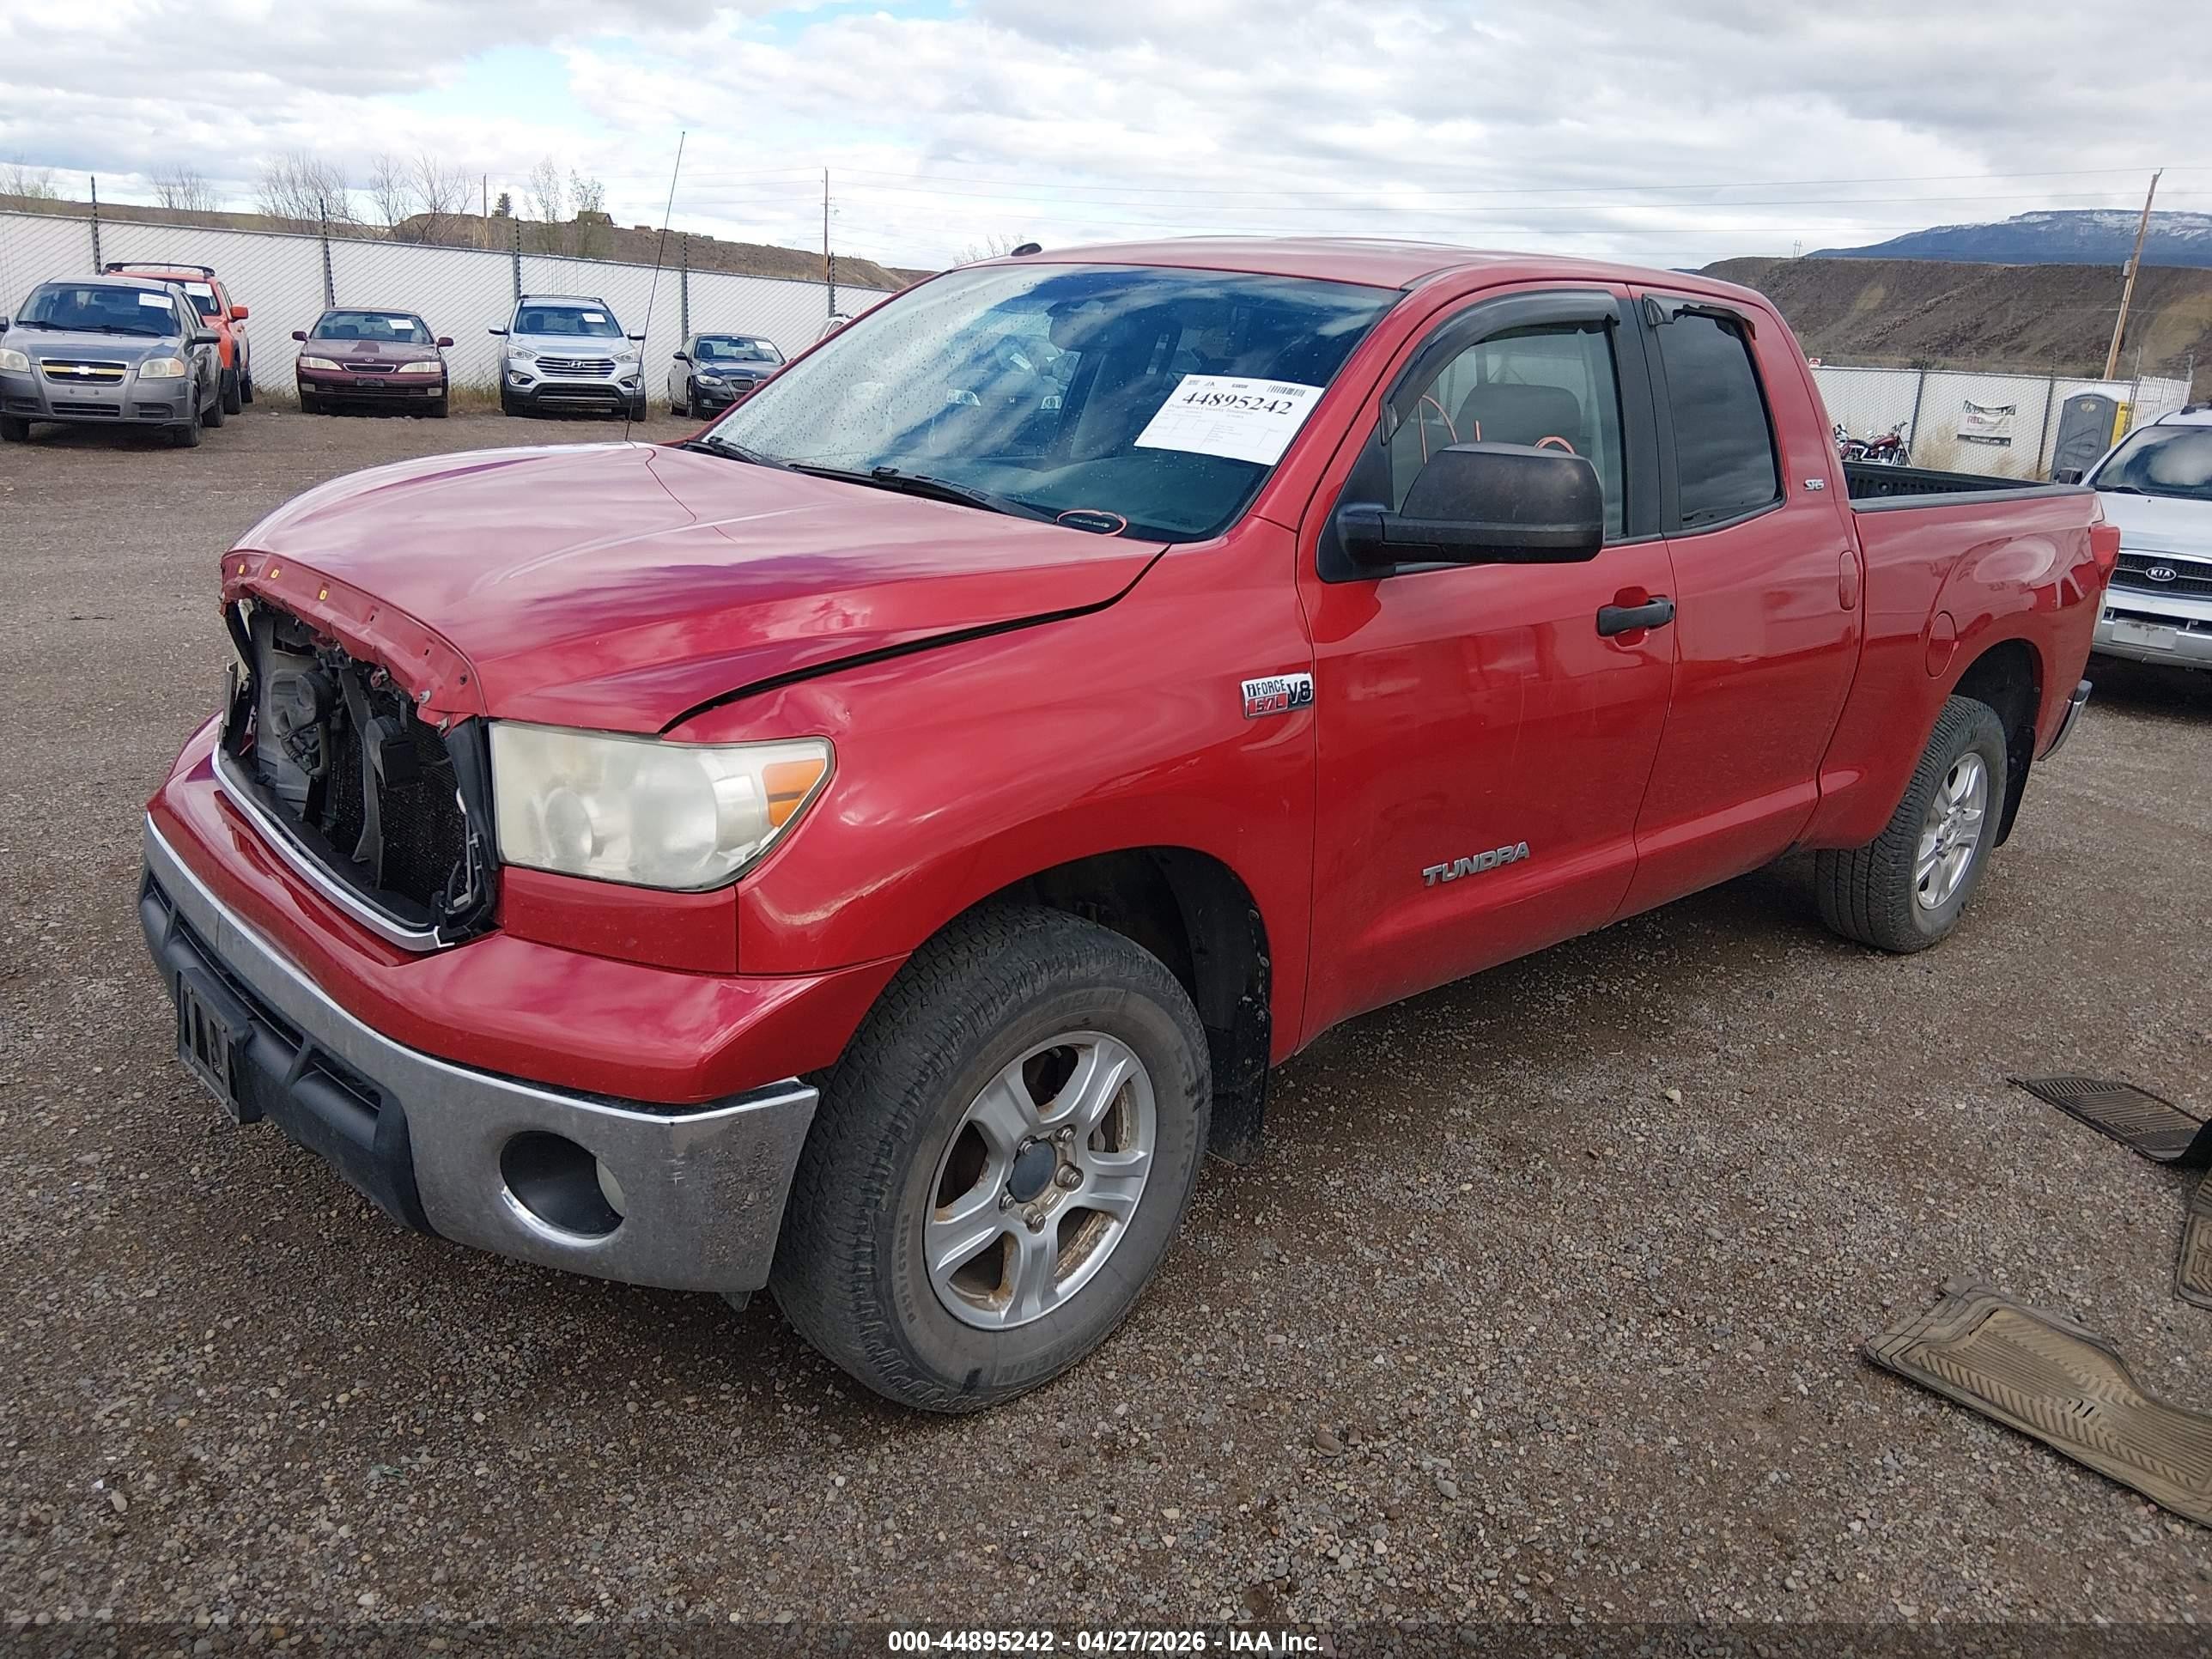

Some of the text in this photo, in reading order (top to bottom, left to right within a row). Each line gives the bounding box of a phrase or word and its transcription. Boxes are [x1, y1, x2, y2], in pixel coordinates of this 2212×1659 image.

[1182, 391, 1293, 415] 44895242
[2150, 568, 2171, 579] KIA
[1287, 679, 1312, 704] V8
[1423, 841, 1530, 886] TUNDRA
